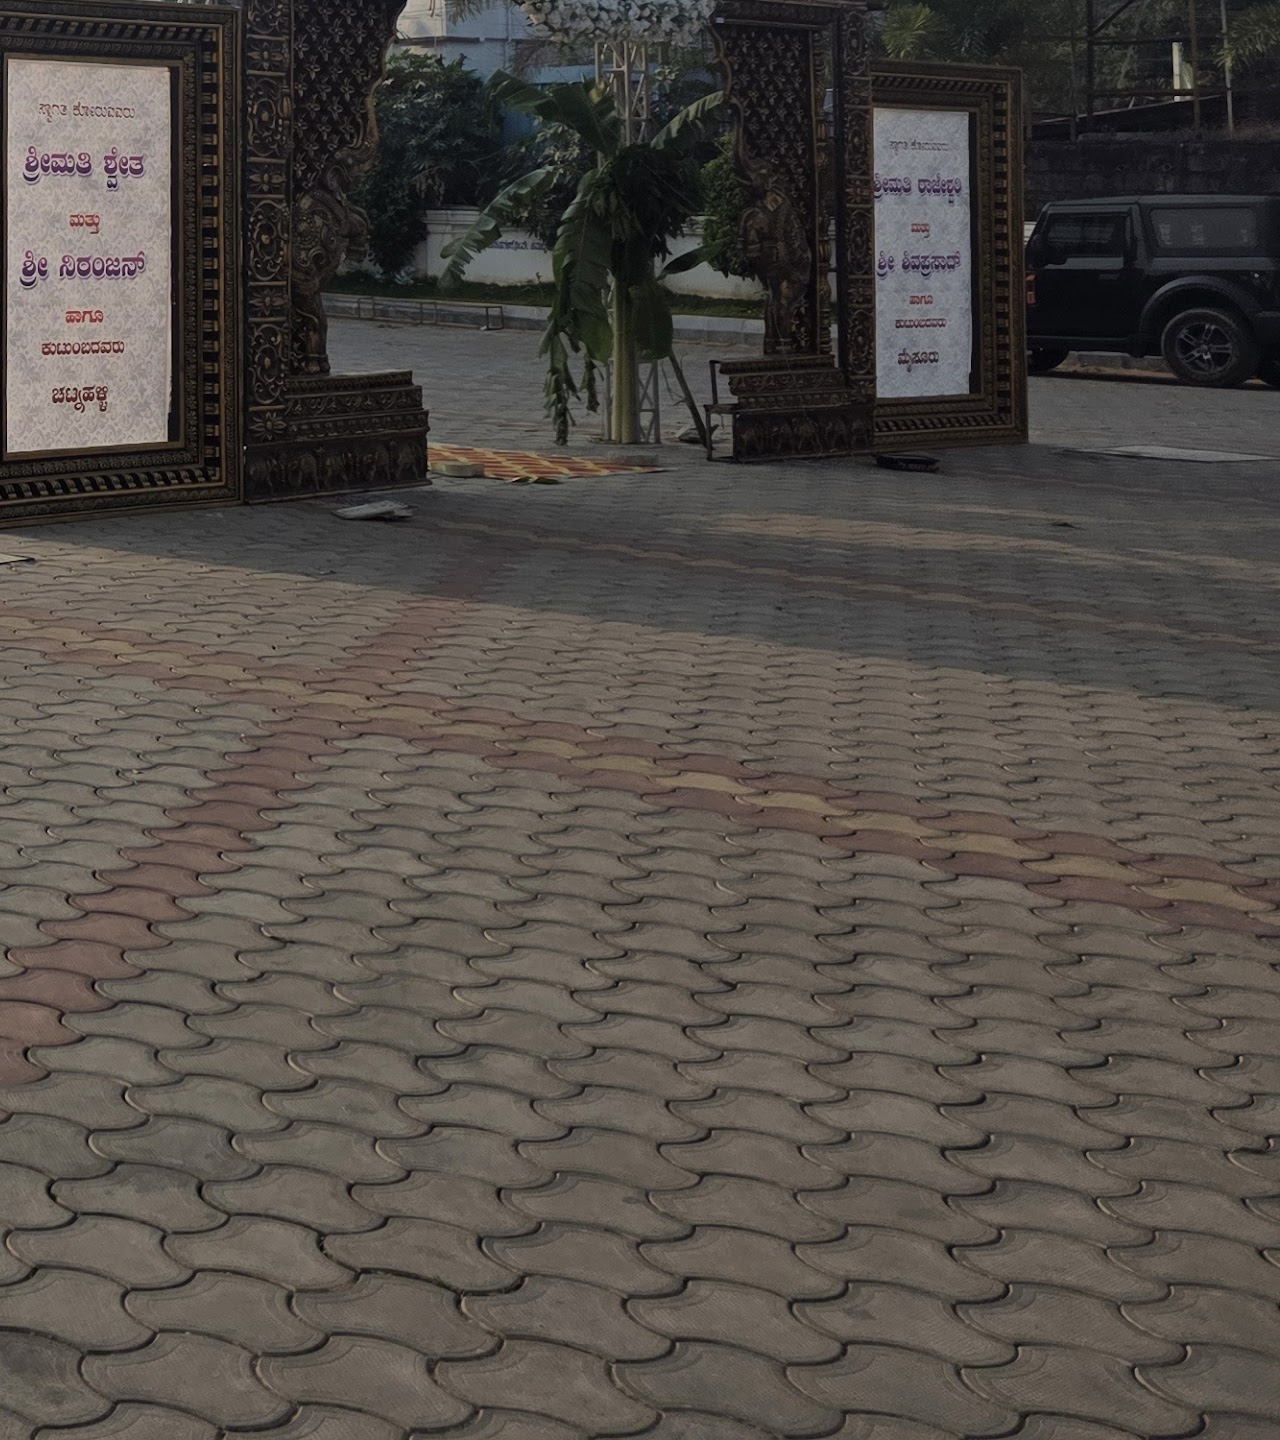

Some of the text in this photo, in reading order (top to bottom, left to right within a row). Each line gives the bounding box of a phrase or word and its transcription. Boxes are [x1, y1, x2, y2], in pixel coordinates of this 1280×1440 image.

[23, 145, 145, 190] ಶ್ರೀಮತಿ ಶ್ವೇತ
[874, 173, 962, 205] ಶ್ರೀಮತಿ ರಾಜೇಶ್ವರಿ
[69, 212, 101, 235] ಮತ್ತು
[20, 250, 146, 288] ಶ್ರೀ ನಿರಂಜನ್
[877, 250, 961, 278] ಶ್ರೀ ಶಿವಪ್ರಸಾದ್
[65, 308, 104, 324] ಹಾಗೂ
[41, 340, 125, 356] ಕುಟುಂಬದವರು
[897, 347, 940, 373] ಮೈಸೂರು
